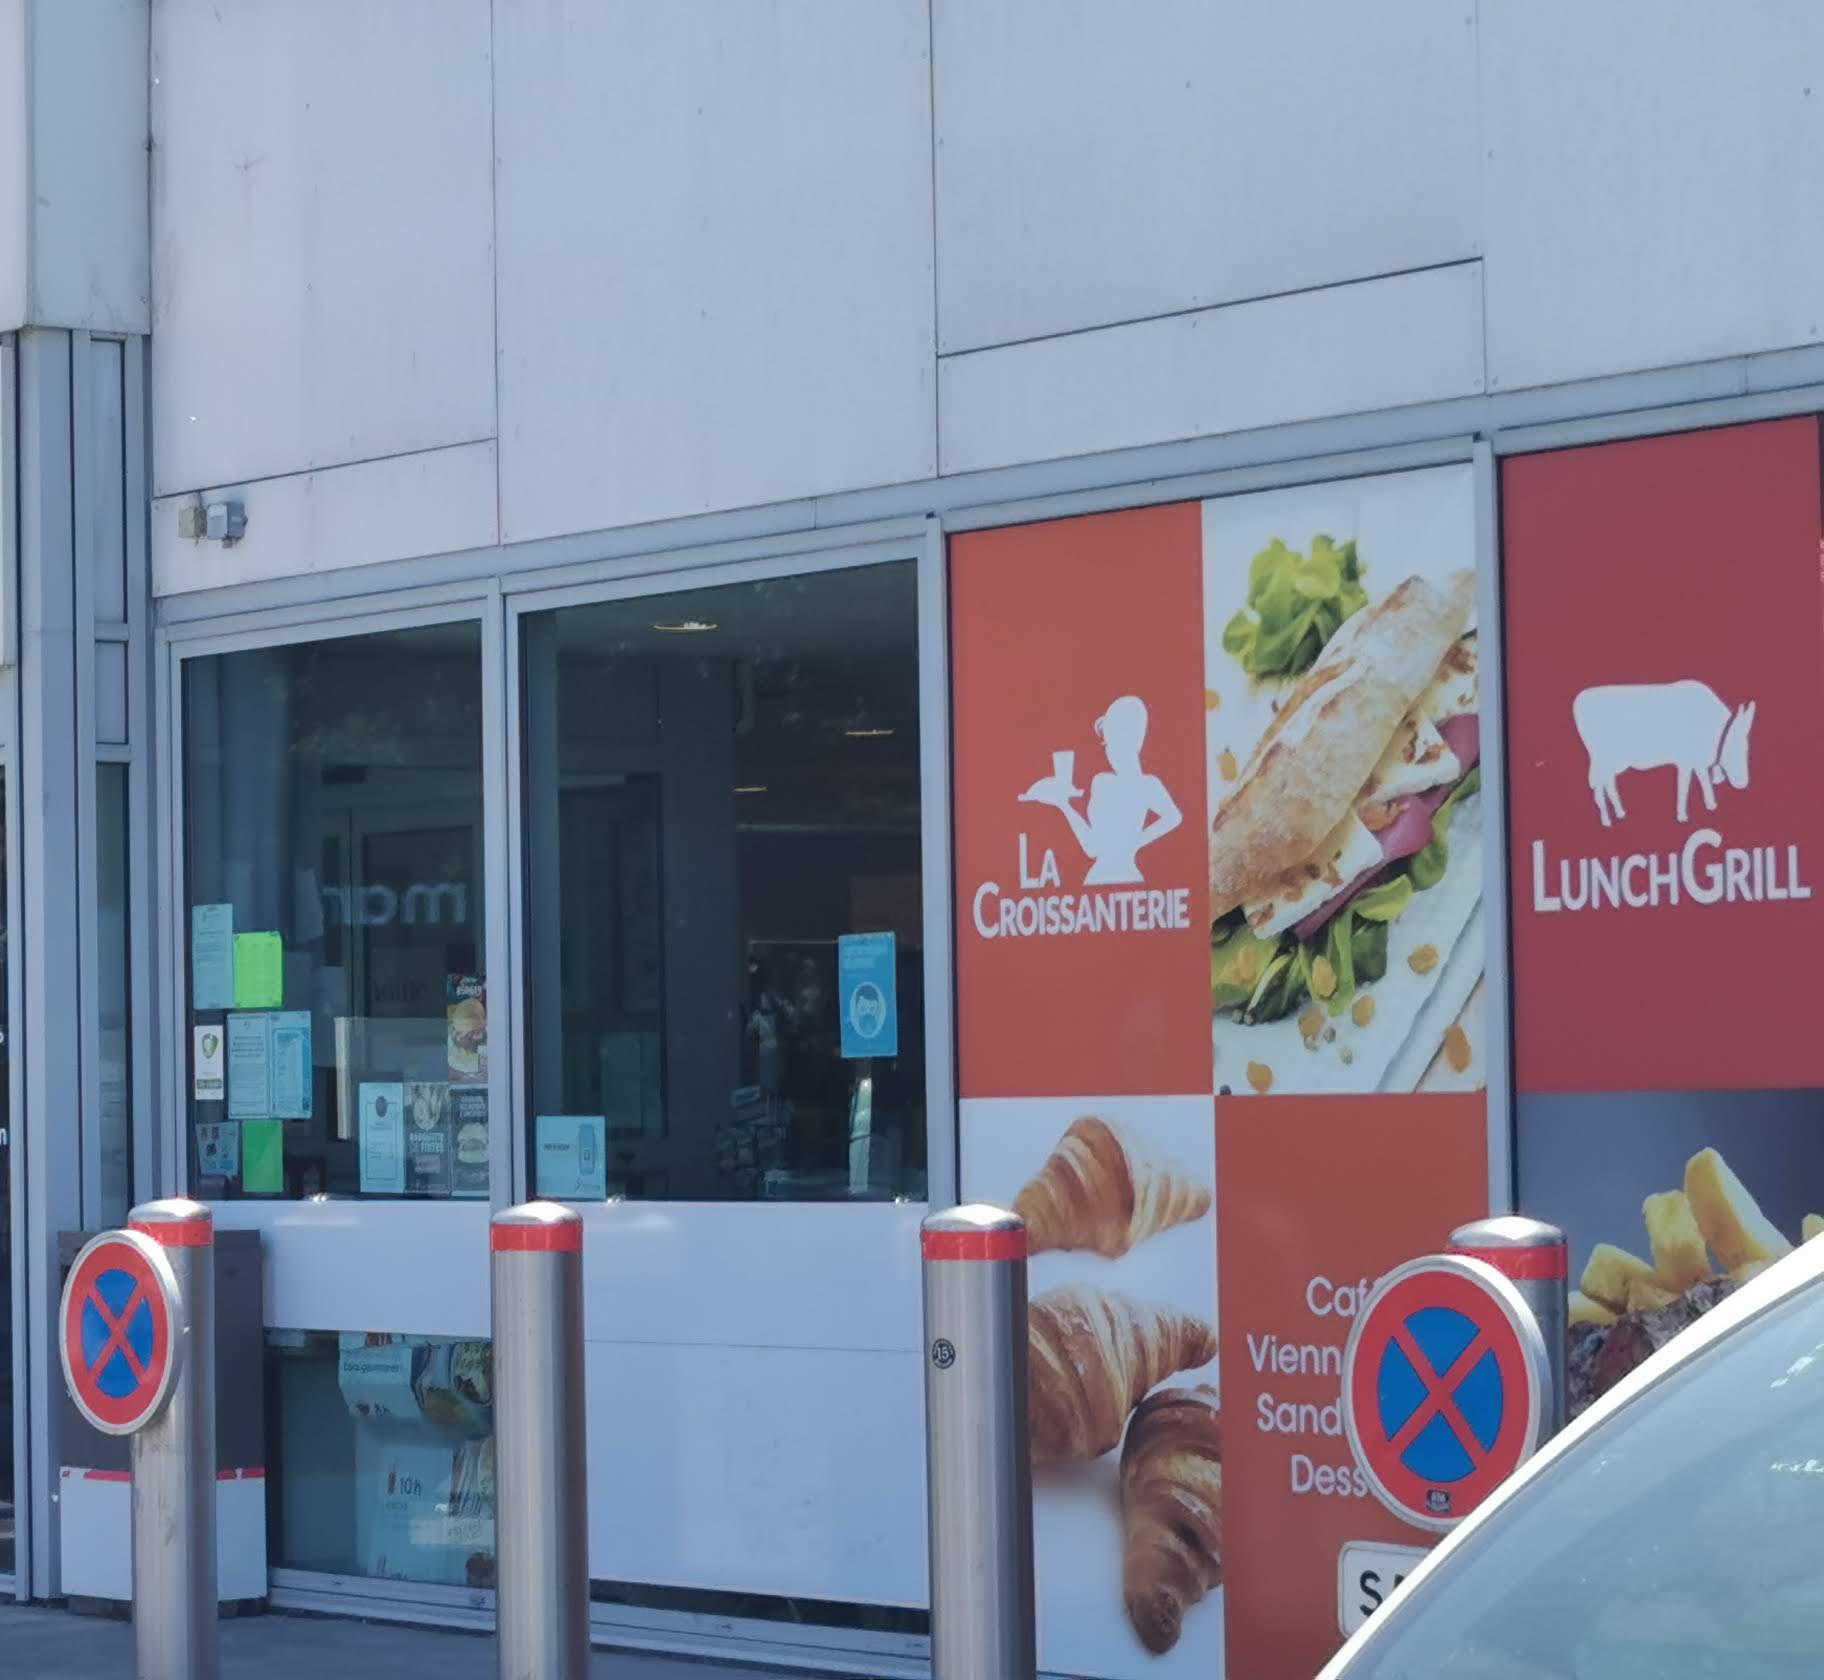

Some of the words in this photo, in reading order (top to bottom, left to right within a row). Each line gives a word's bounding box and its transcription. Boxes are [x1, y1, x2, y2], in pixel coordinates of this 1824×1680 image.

[1018, 833, 1061, 889] LA
[973, 881, 1191, 939] CROISSANTERIE
[1247, 1333, 1342, 1376] Vienn
[1257, 1393, 1344, 1435] Sand
[1291, 1455, 1377, 1497] Dess
